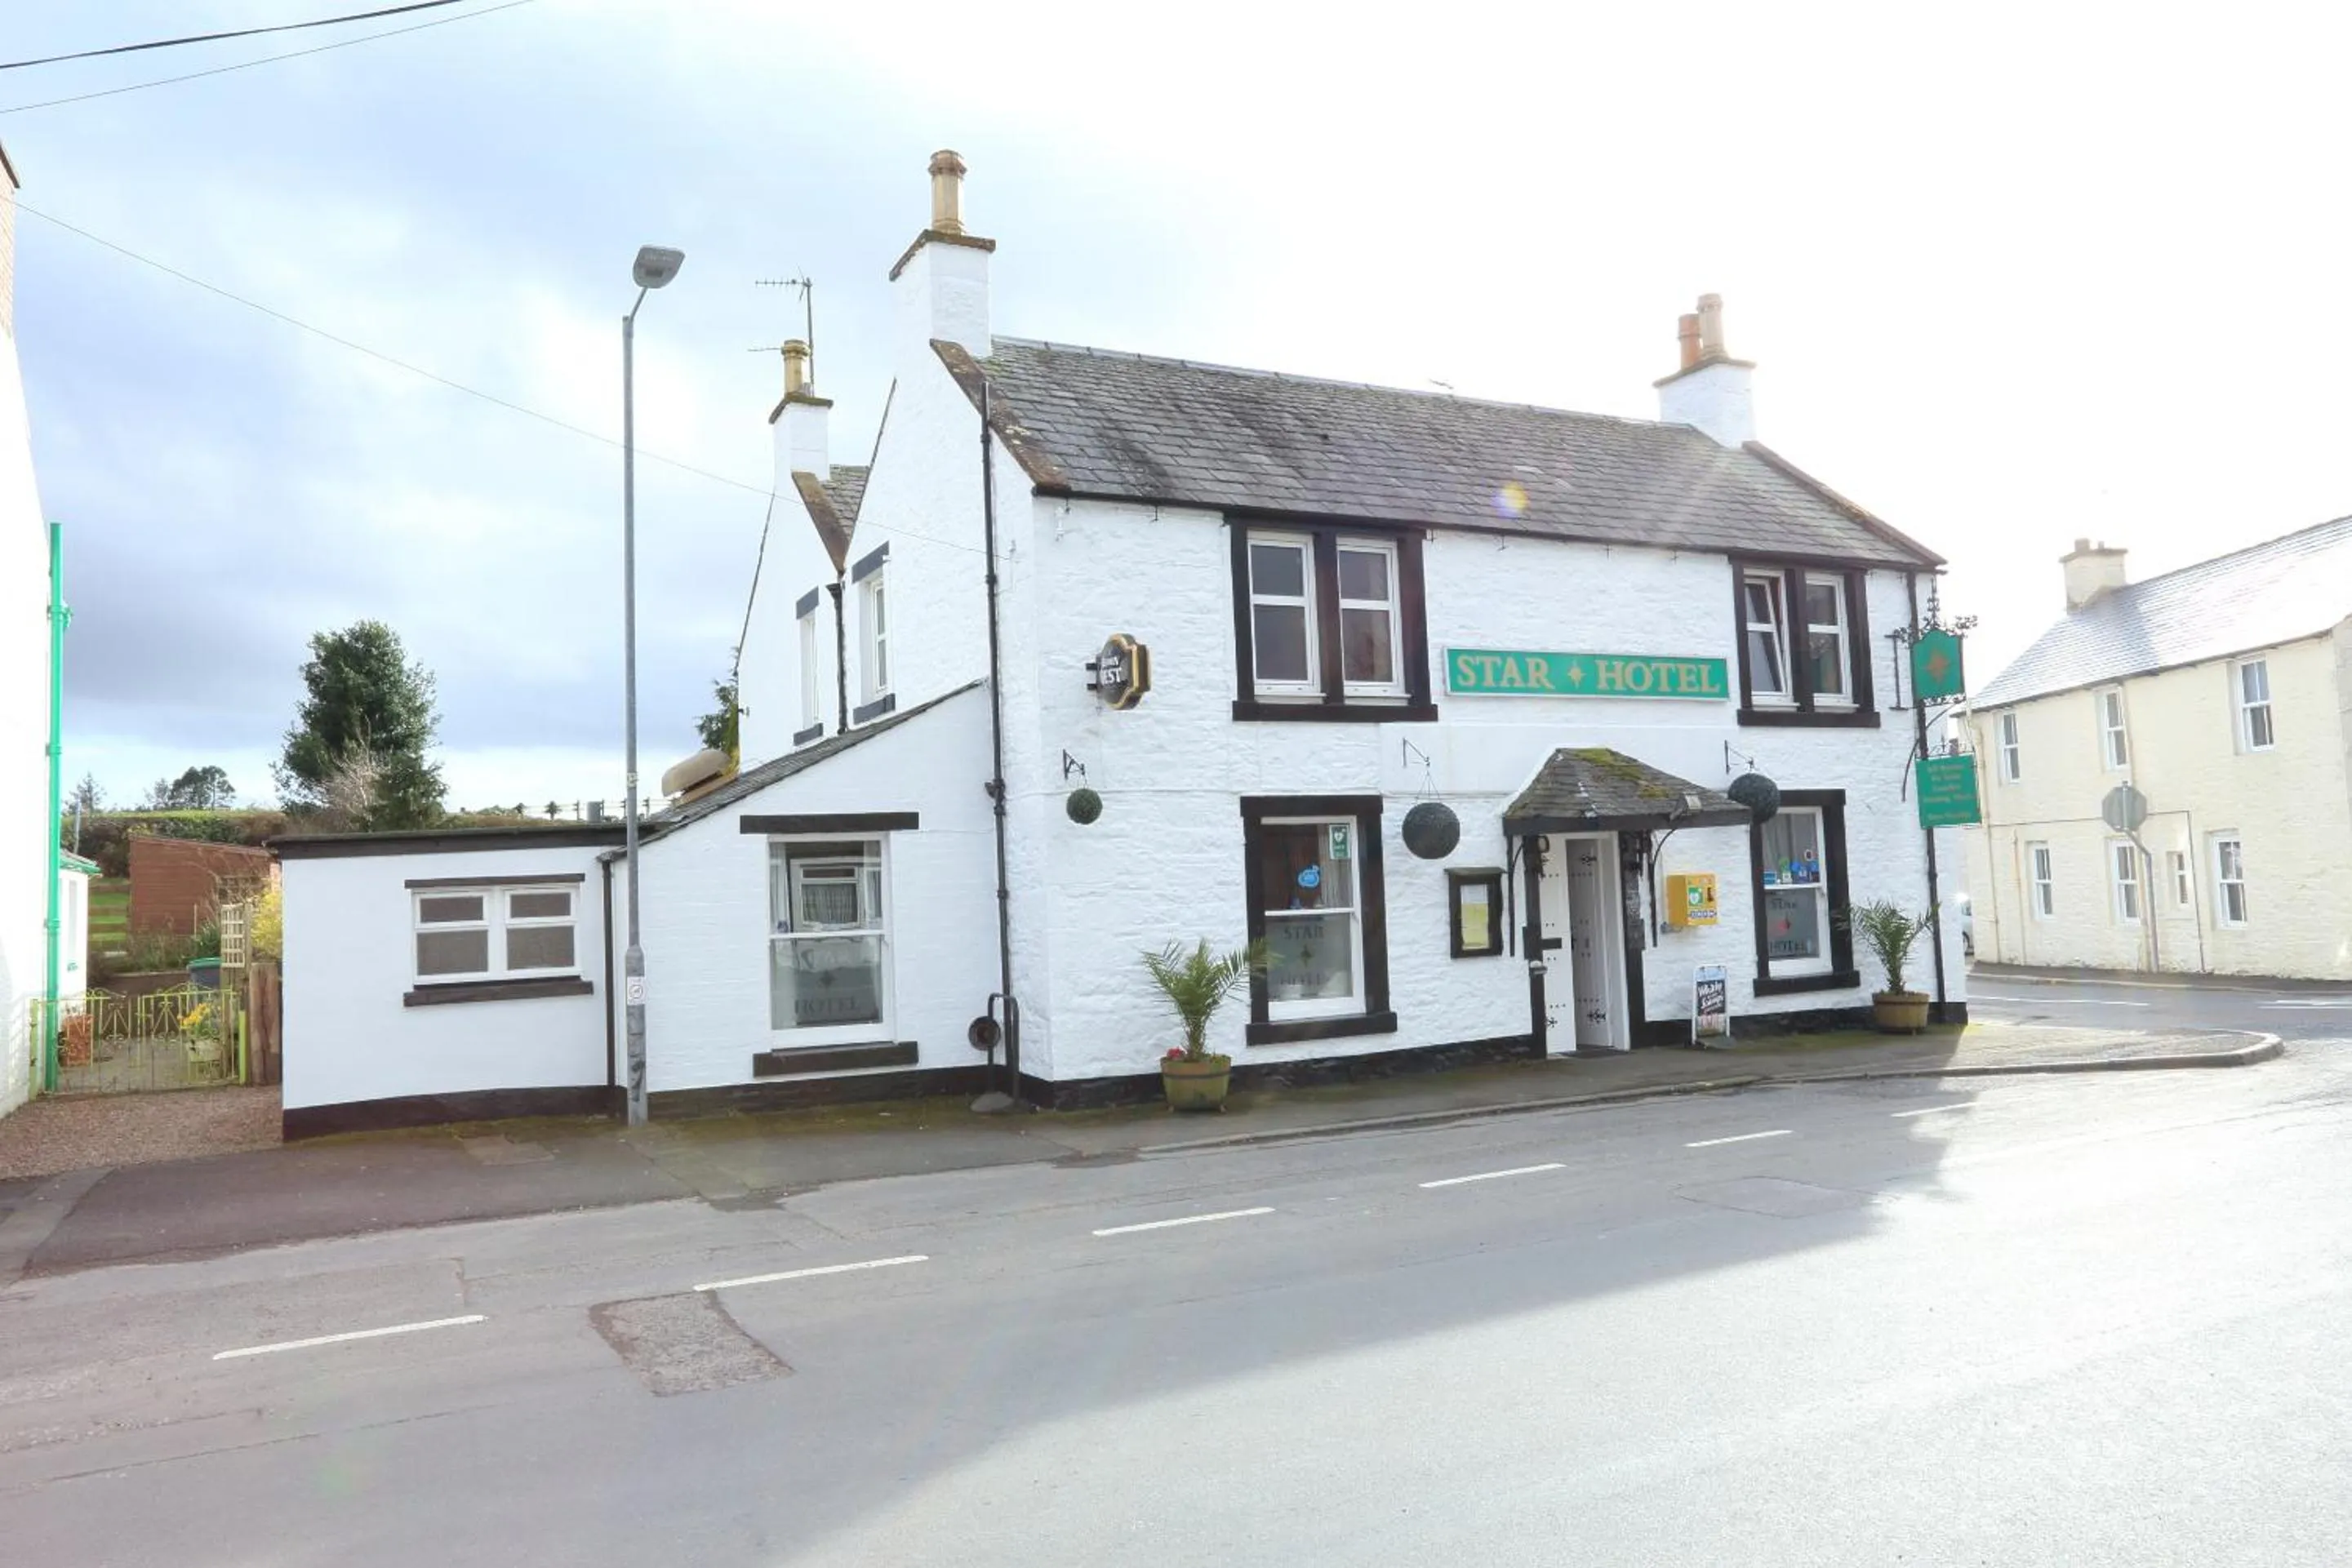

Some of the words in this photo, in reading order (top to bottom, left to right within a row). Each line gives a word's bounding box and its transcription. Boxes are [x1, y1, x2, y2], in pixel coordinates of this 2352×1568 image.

[1456, 655, 1554, 690] STAR
[1595, 660, 1720, 694] HOTEL
[1283, 924, 1325, 940] STAR
[794, 996, 861, 1015] HOTEL
